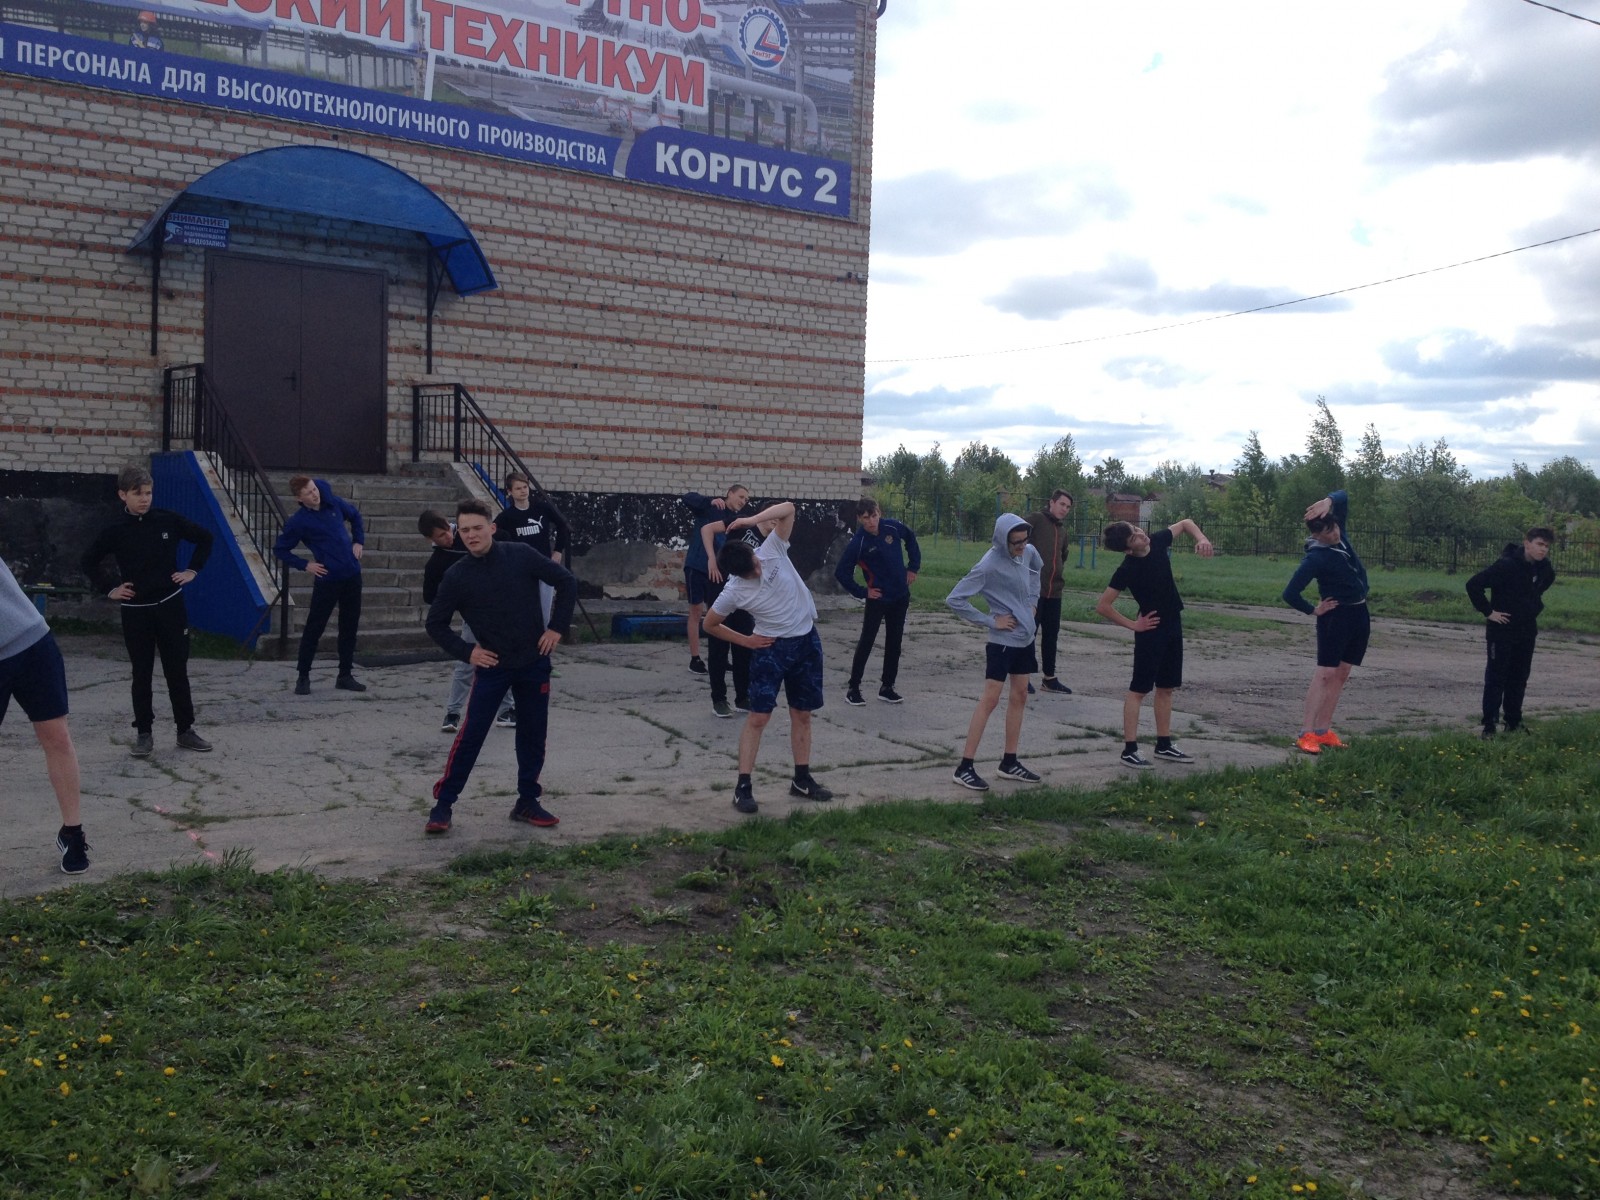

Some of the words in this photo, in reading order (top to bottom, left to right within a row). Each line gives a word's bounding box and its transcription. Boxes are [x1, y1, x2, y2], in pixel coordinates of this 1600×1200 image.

[421, 0, 705, 108] ТЕХНИКУМ
[17, 40, 152, 85] ПЕРСОНАЛА
[161, 66, 207, 94] ДЛЯ
[217, 76, 470, 140] ВЫСОКОТЕХНОЛОГИЧНОГО
[478, 123, 607, 166] ПРОИЗВОДСТВА
[655, 142, 803, 199] КОРПУС
[813, 167, 838, 204] 2
[516, 525, 540, 537] PUMA
